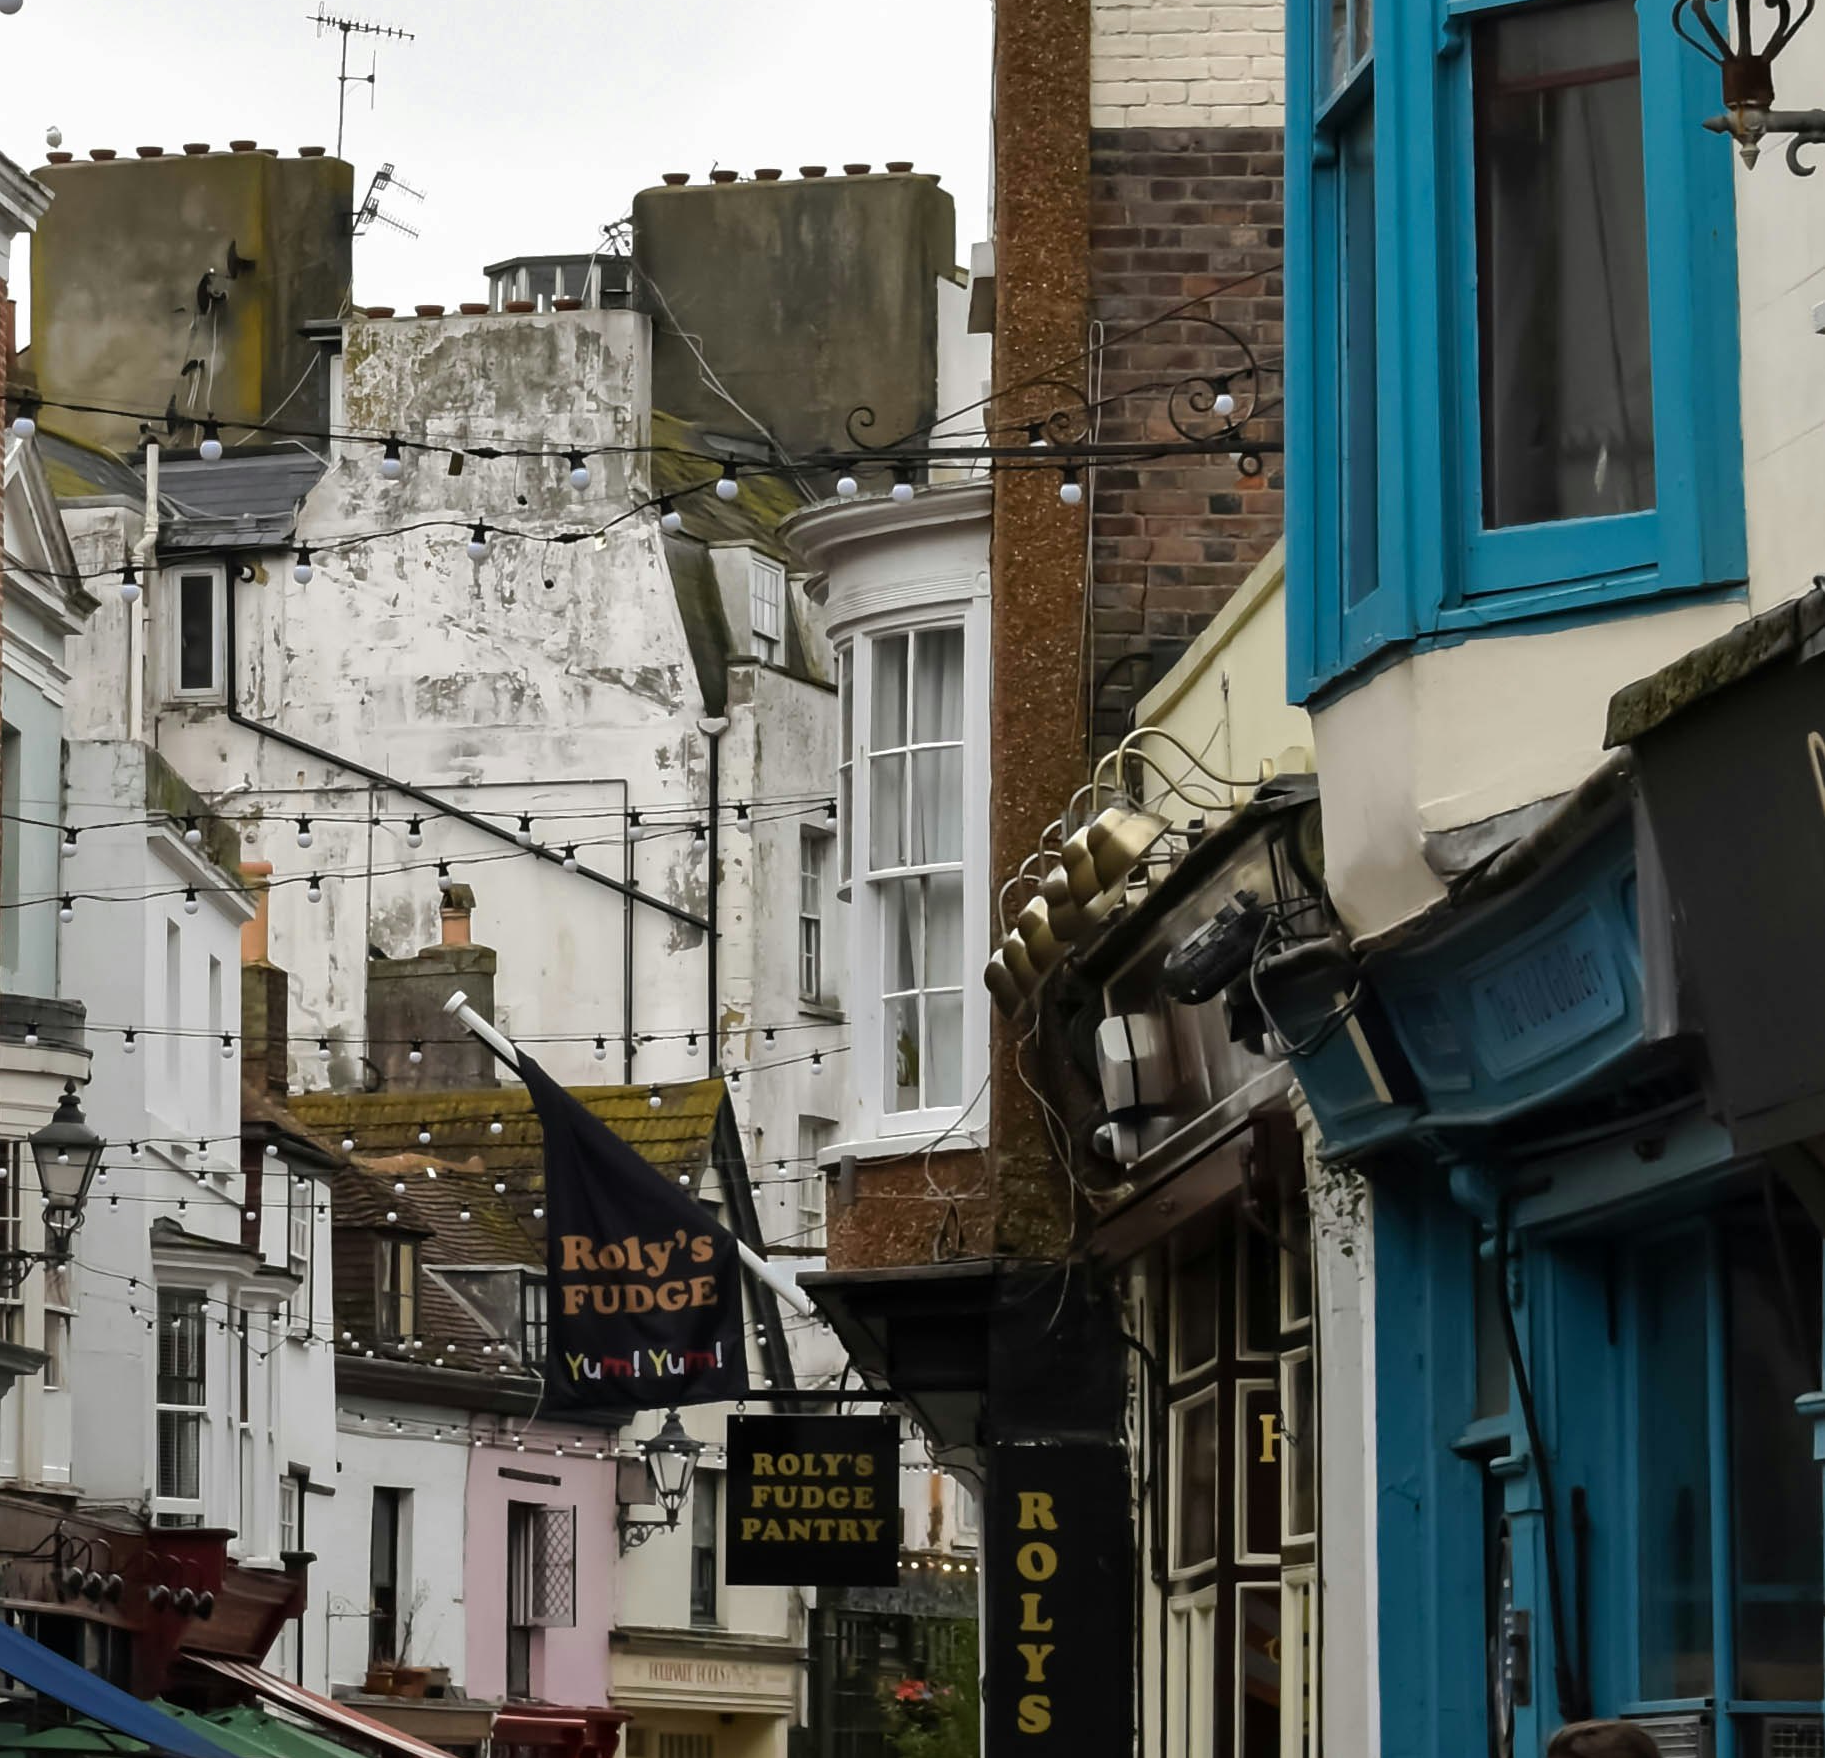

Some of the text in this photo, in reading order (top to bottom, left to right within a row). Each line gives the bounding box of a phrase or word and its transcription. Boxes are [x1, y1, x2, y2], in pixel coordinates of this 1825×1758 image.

[559, 1230, 714, 1280] Roly's
[562, 1273, 718, 1316] FUDGE
[564, 1340, 724, 1382] Yum! Yum!
[751, 1452, 875, 1478] ROLY'S
[750, 1485, 876, 1510] FUDGE
[741, 1517, 885, 1543] PANTRY
[1015, 1491, 1060, 1735] ROLYS
